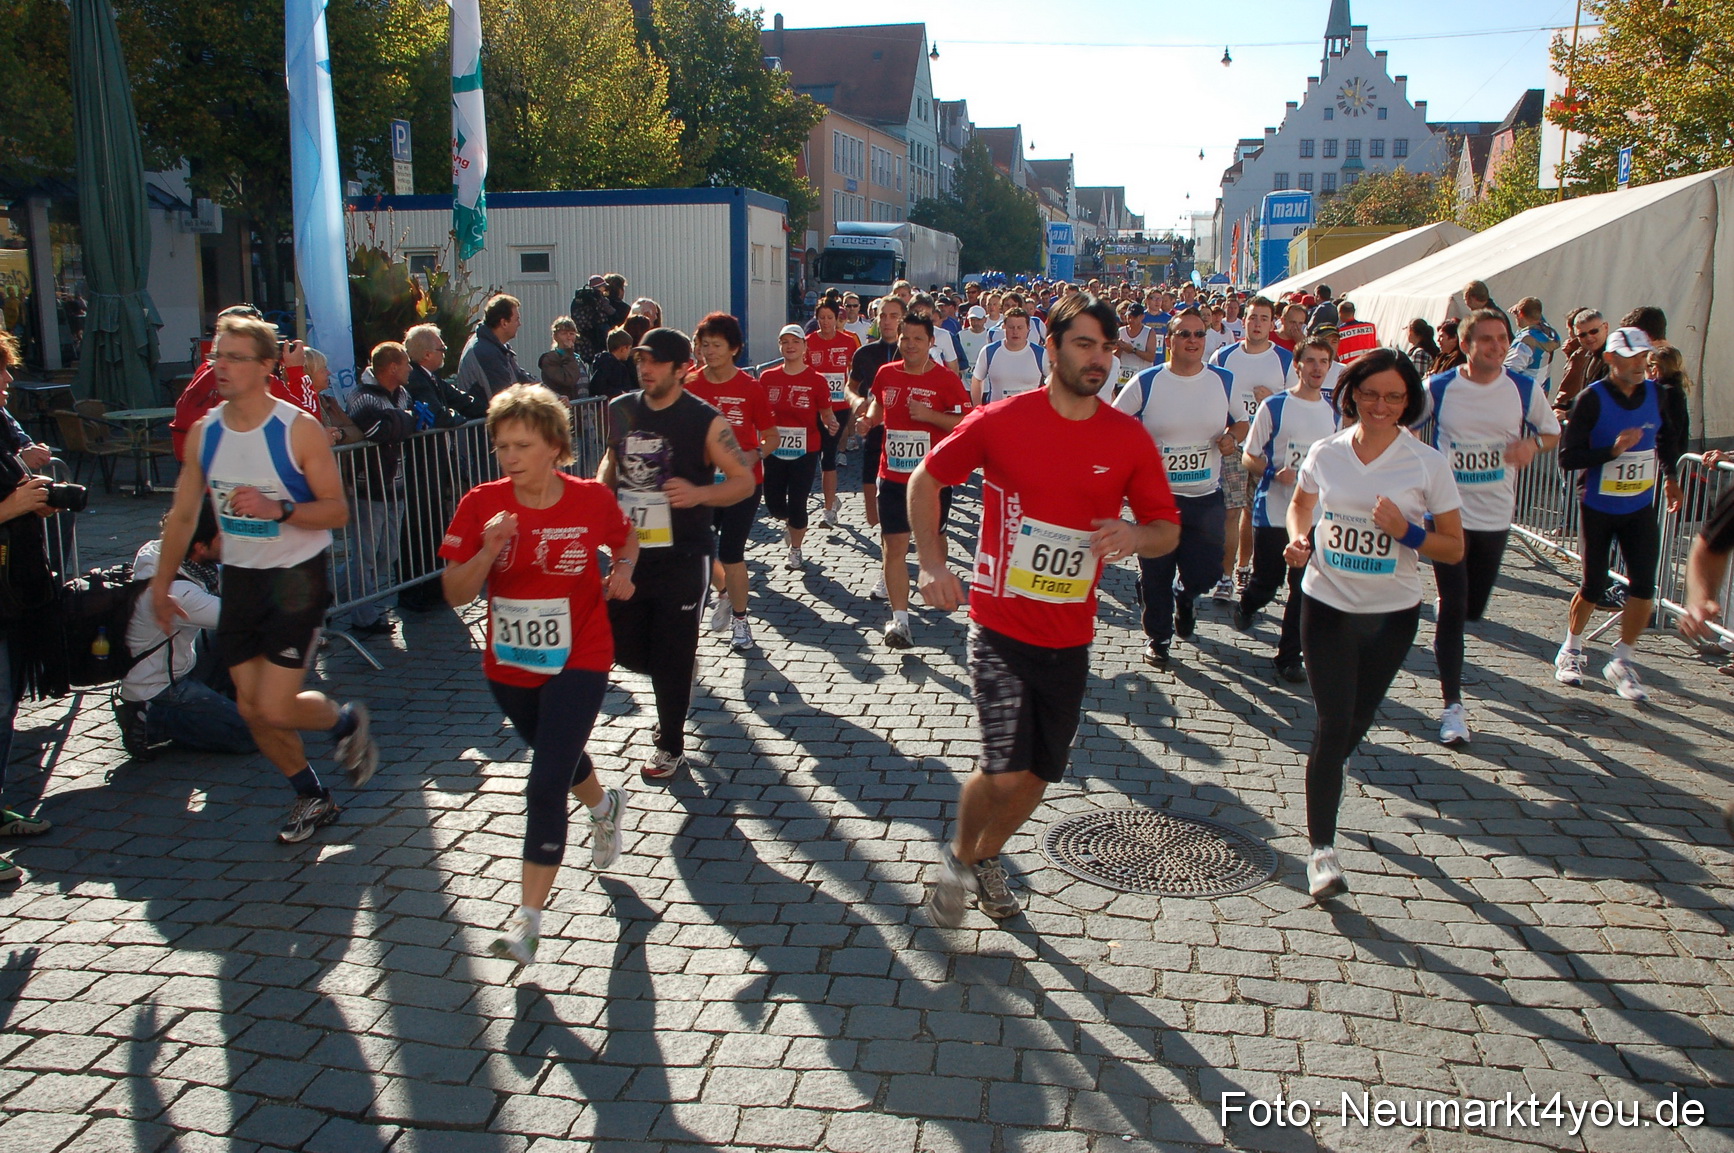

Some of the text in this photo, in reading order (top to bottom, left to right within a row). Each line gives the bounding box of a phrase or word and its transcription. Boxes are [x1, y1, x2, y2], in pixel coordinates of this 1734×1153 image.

[395, 125, 406, 154] P
[1620, 152, 1629, 179] P
[1272, 199, 1307, 218] maxi
[1340, 326, 1373, 338] NOTARZT
[889, 441, 925, 458] 3370
[895, 458, 920, 468] Bernd
[1168, 452, 1208, 471] 2397
[1454, 450, 1500, 470] 3038
[1171, 470, 1207, 482] Dominik
[1456, 471, 1497, 483] Andreas
[1615, 463, 1645, 480] 181
[1328, 525, 1392, 557] 3039
[1032, 543, 1084, 577] 603
[1331, 552, 1382, 571] Claudia
[1031, 574, 1073, 594] Franz
[498, 617, 559, 647] 3188
